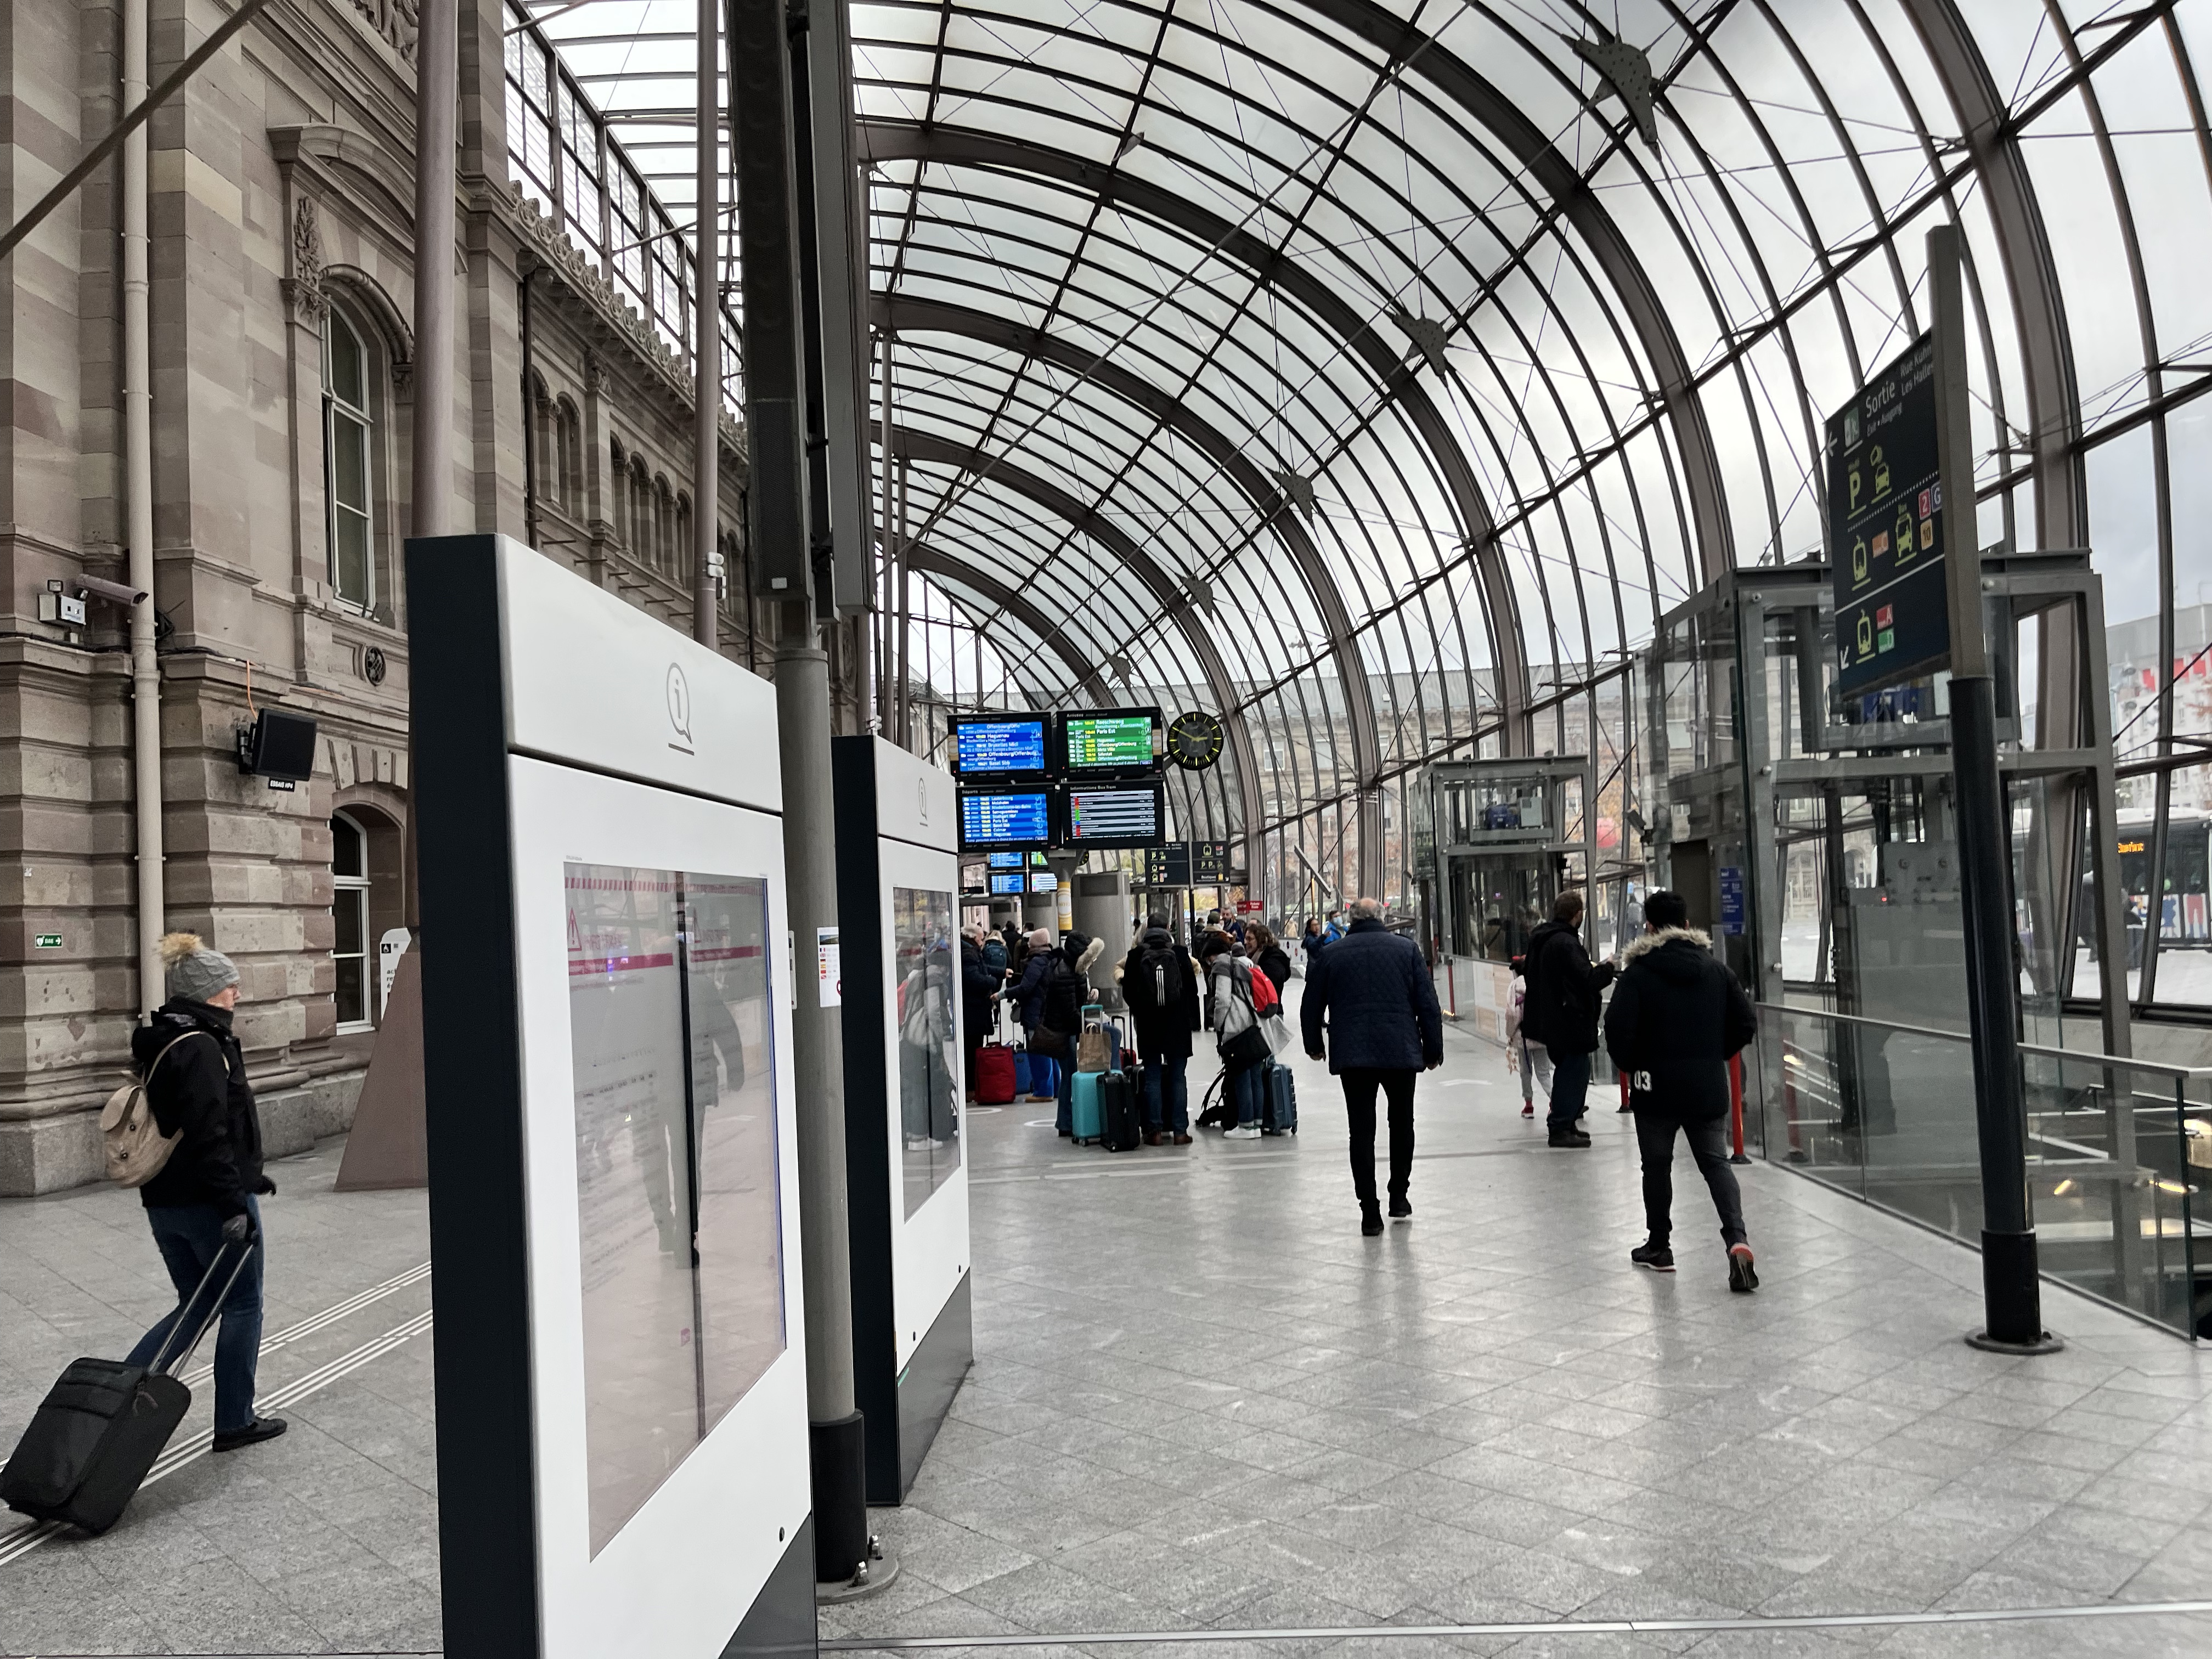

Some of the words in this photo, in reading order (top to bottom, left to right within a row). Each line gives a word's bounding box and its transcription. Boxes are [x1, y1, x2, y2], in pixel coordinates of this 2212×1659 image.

[1900, 360, 1913, 378] Rue
[1901, 379, 1912, 396] Les
[1914, 362, 1932, 386] Halle
[1865, 380, 1895, 418] Sortie
[1034, 795, 1045, 836] départs
[1634, 1070, 1652, 1091] 03
